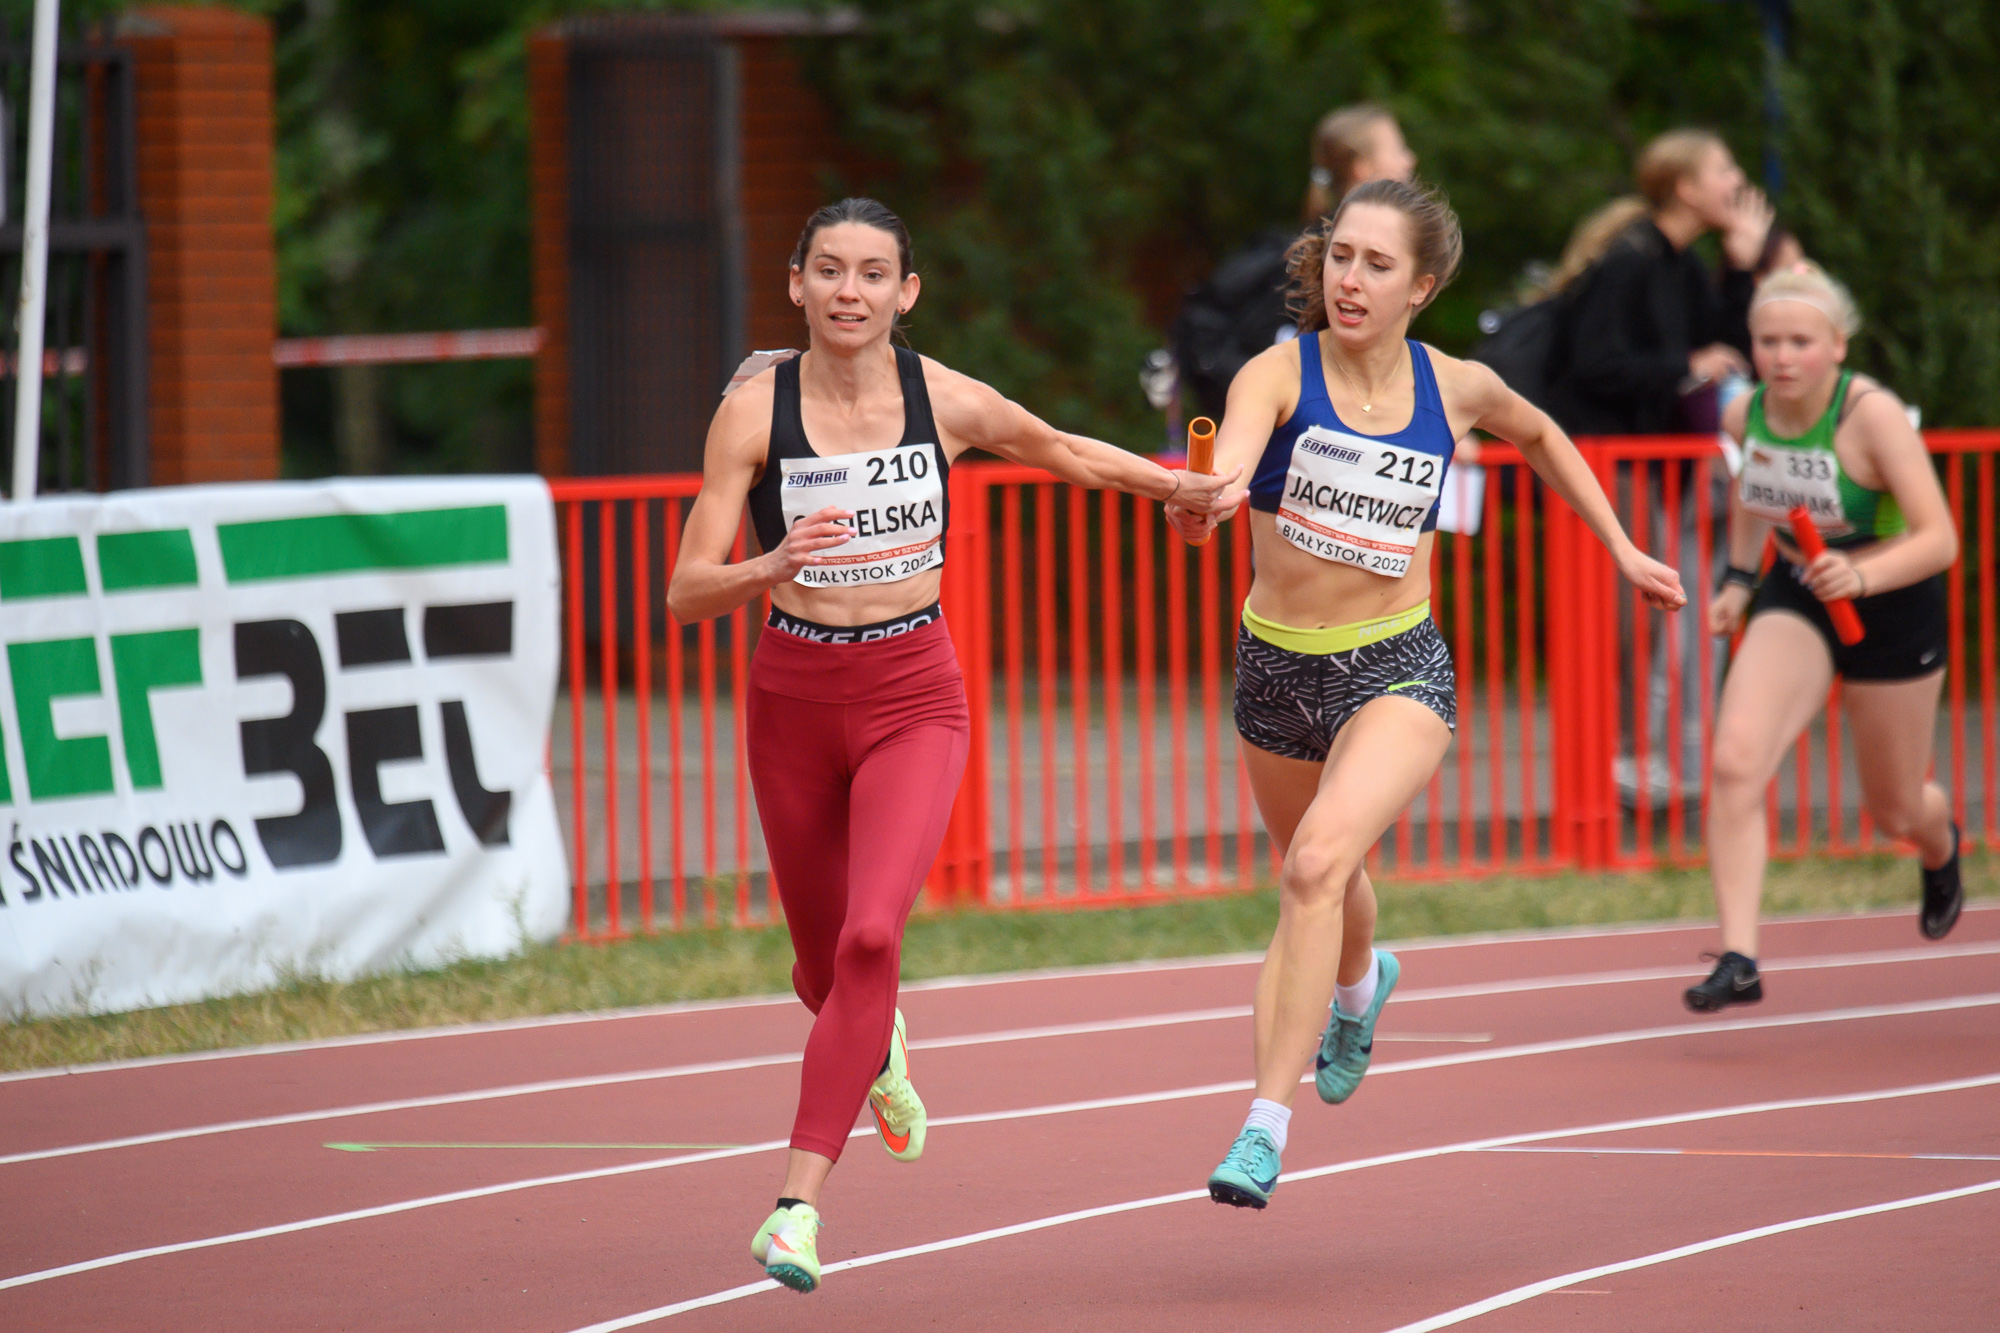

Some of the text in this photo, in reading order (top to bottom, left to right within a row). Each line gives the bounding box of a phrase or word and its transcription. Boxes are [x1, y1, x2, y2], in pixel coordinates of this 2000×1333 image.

[1301, 438, 1364, 464] SONAROL
[787, 470, 848, 487] SONAROL
[866, 450, 928, 487] 210
[1375, 451, 1434, 488] 212
[1787, 456, 1831, 480] 333
[1289, 476, 1425, 530] JACKIEWICZ
[1282, 524, 1406, 573] BIAŁYSTOK 2022
[1345, 535, 1371, 546] POLSKI
[803, 550, 934, 583] BIAŁYSTOK 2022
[822, 554, 867, 565] STRZOSTWA
[867, 551, 893, 561] POLSKI
[10, 821, 248, 902] ŚNIADOWO
